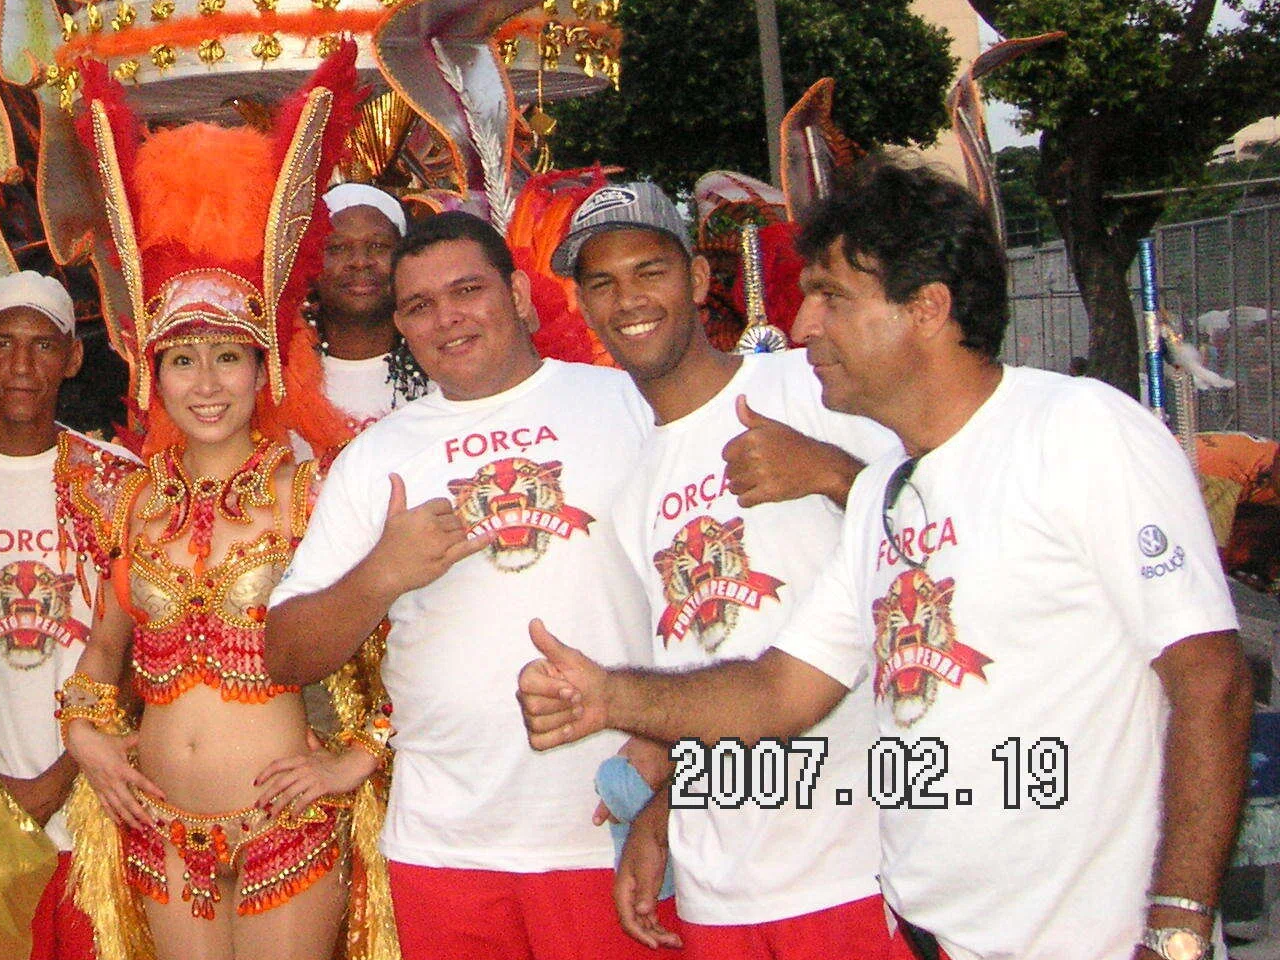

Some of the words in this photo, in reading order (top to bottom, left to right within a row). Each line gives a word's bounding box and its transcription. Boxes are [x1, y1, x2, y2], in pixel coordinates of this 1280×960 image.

[445, 425, 559, 464] FORÇA
[522, 509, 569, 536] PEDRA
[876, 516, 958, 571] FORÇA
[710, 579, 760, 607] PEDRA
[35, 616, 72, 643] PEDRA
[916, 645, 963, 682] PEDRA
